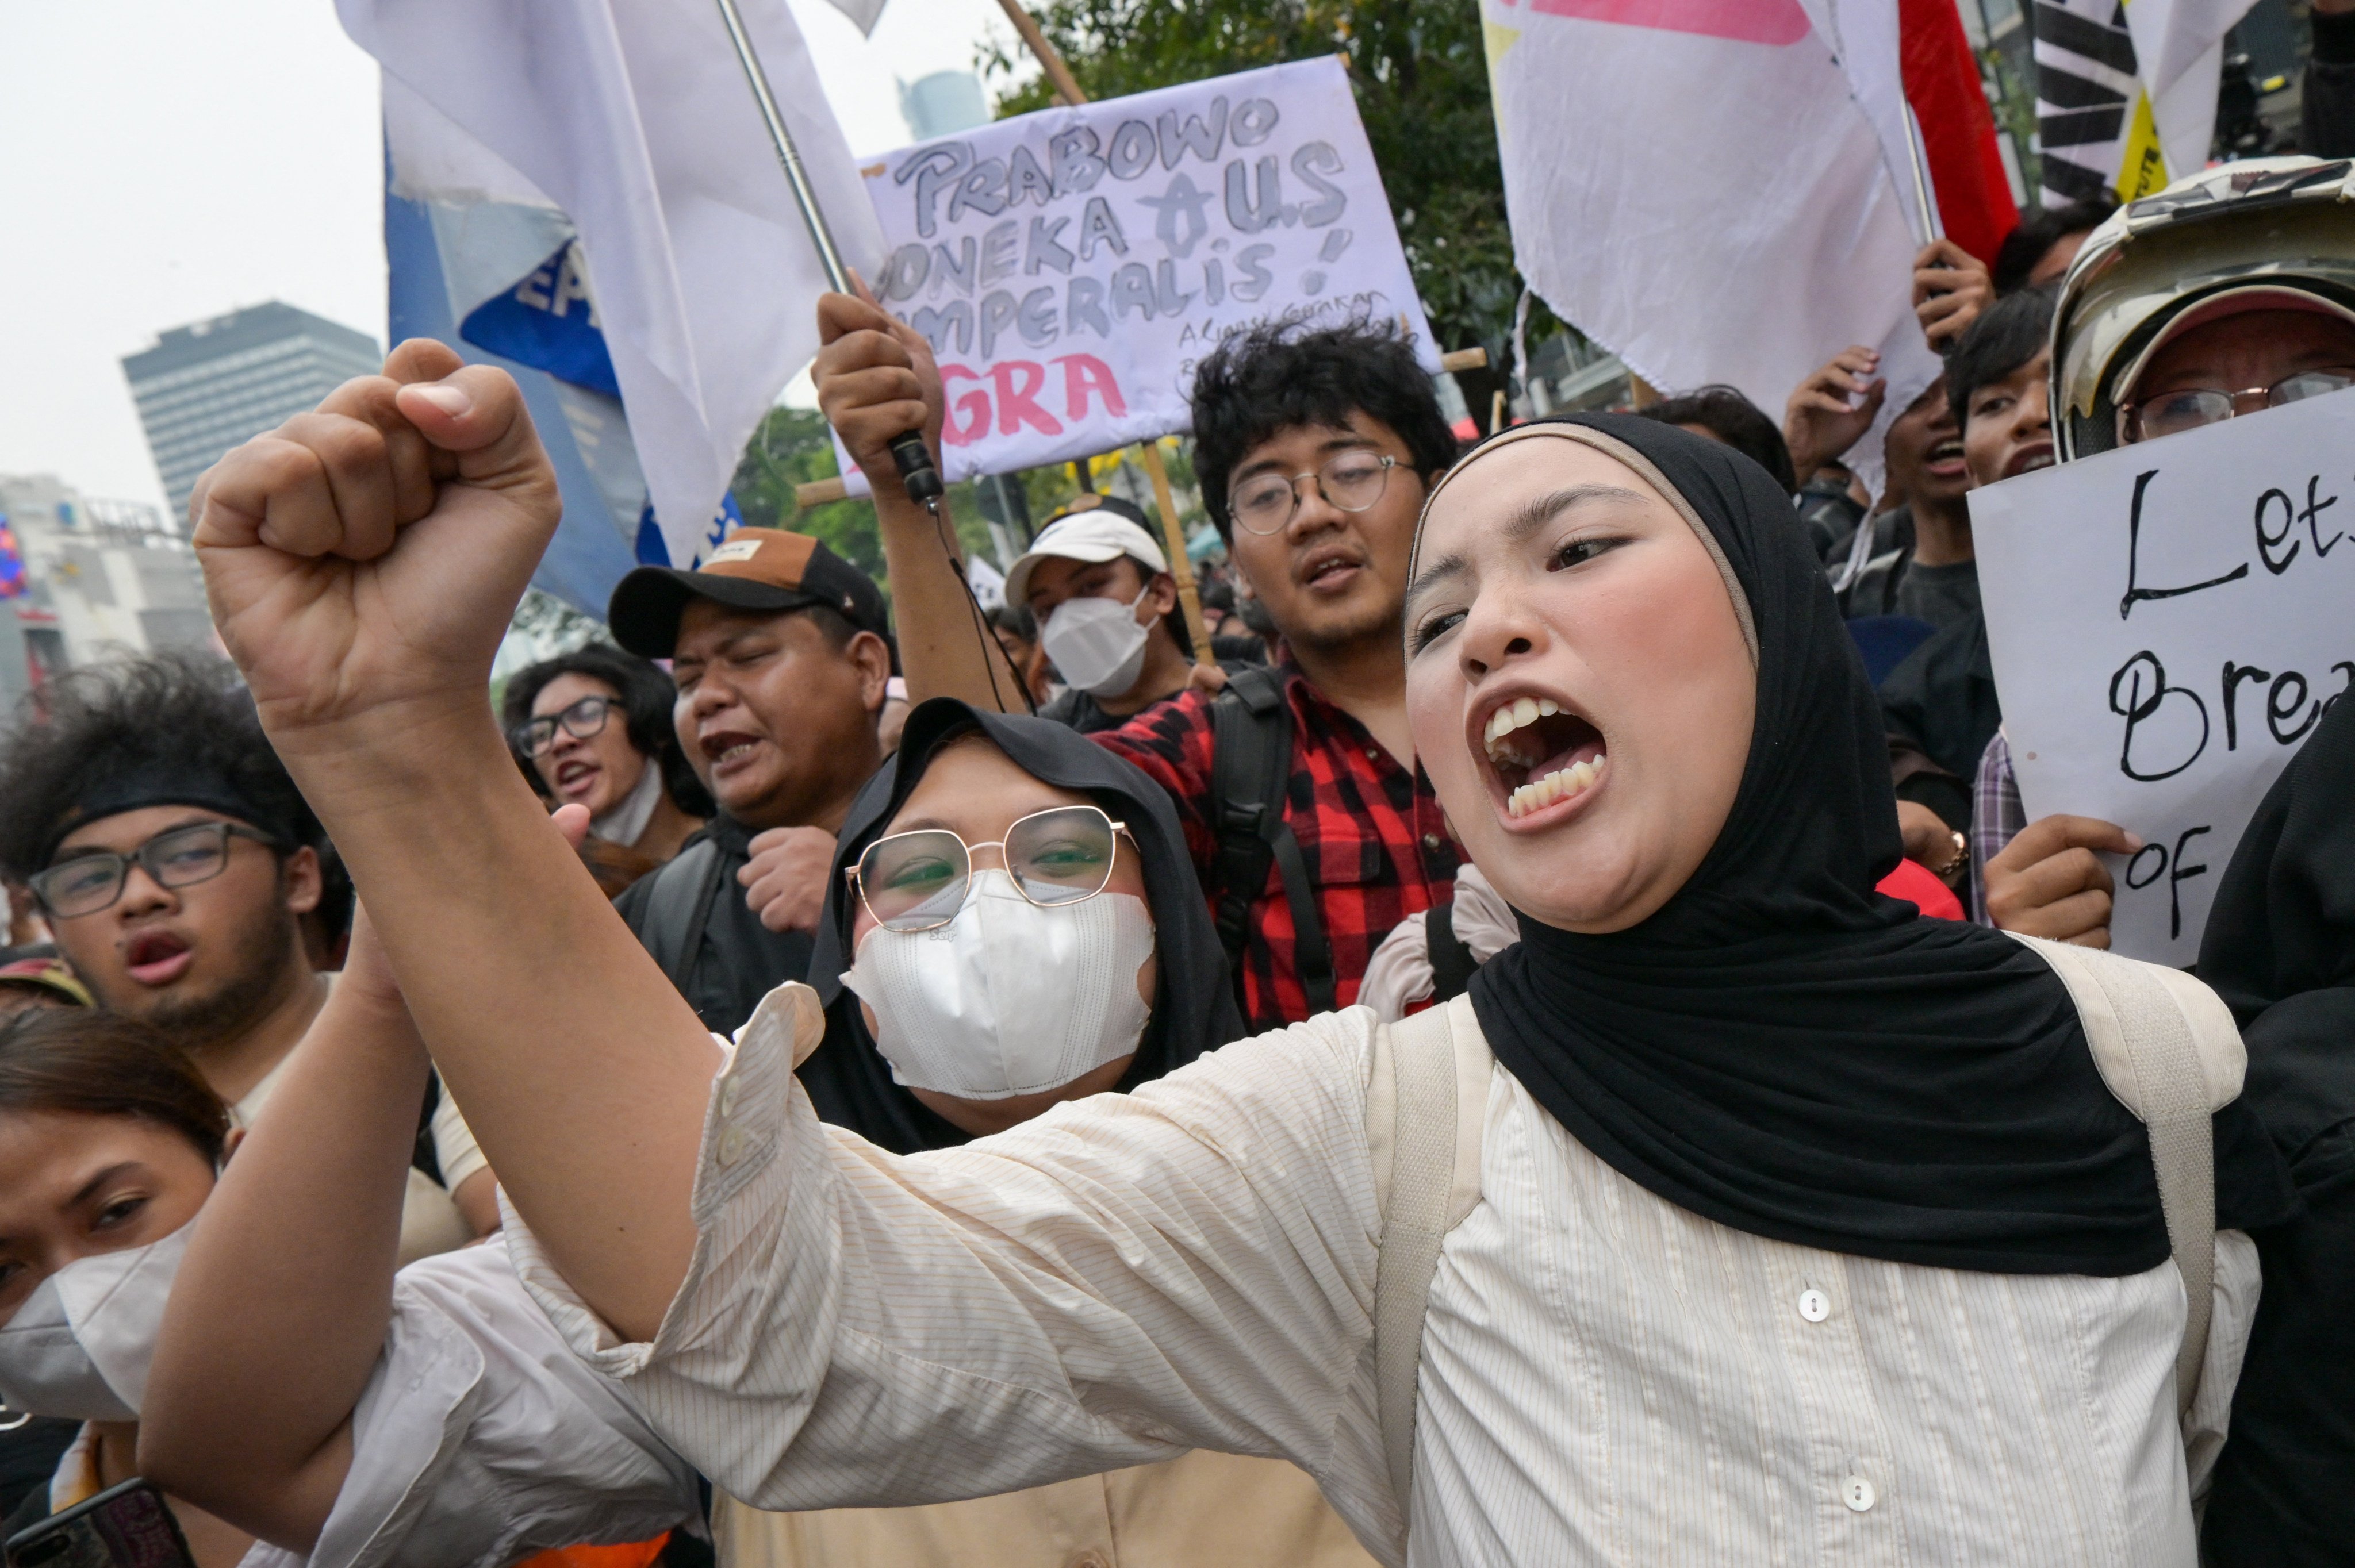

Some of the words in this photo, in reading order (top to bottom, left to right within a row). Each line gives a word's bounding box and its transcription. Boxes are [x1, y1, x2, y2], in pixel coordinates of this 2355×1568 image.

[894, 95, 1280, 239] PRABOWO
[873, 197, 1129, 303] ONEKA
[938, 352, 1127, 448] GRA
[2120, 469, 2355, 621] Let
[2126, 825, 2212, 940] of
